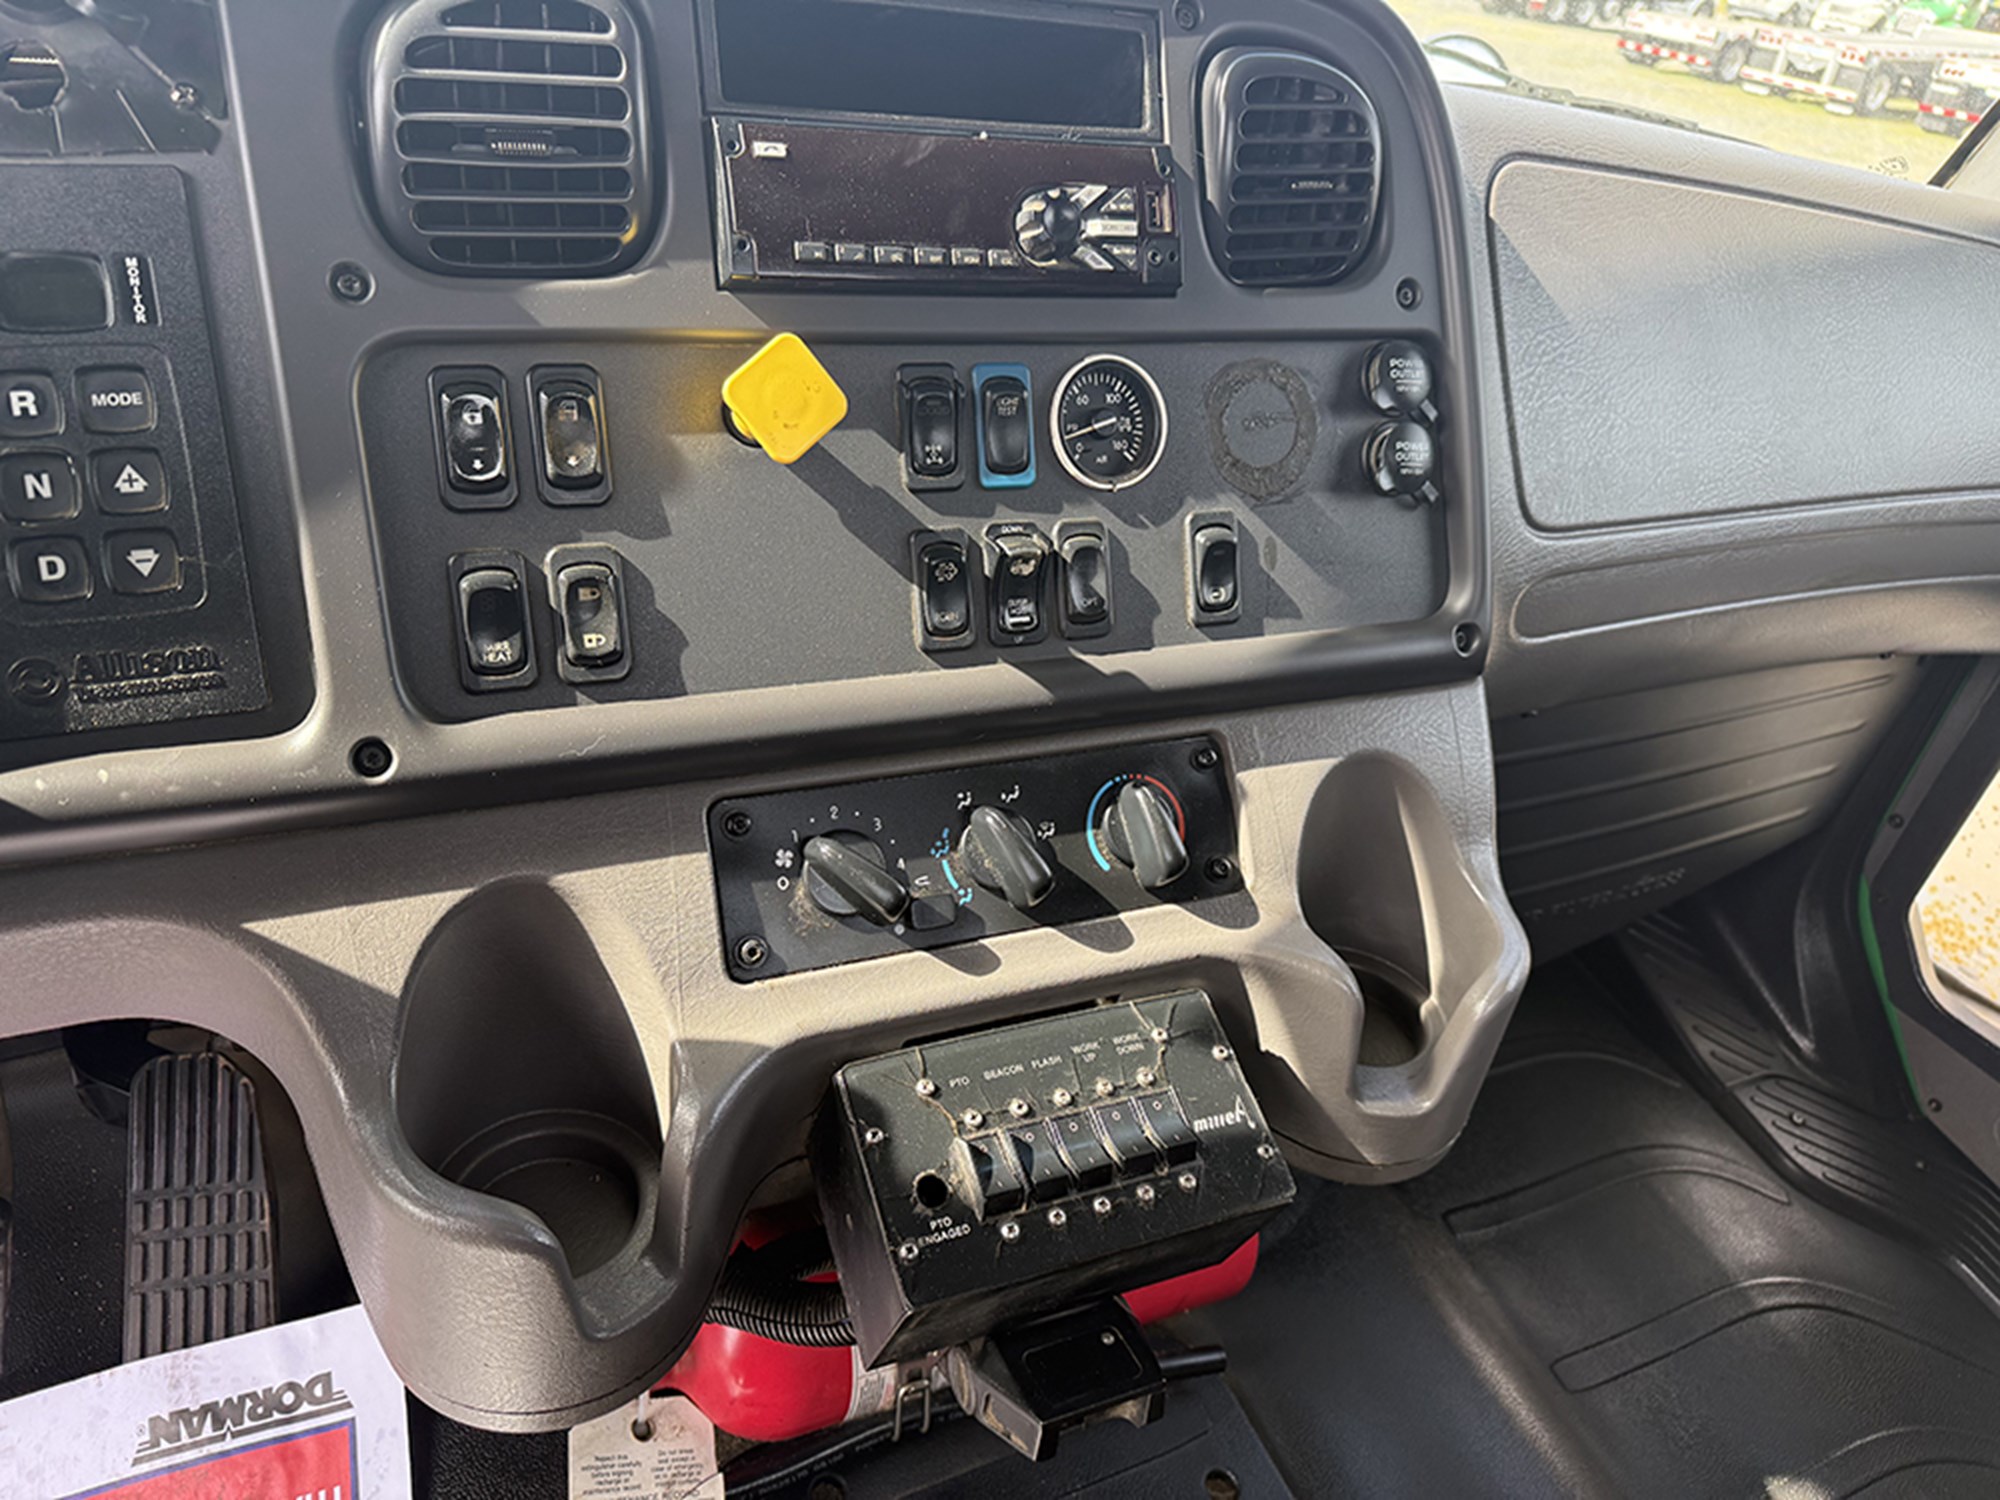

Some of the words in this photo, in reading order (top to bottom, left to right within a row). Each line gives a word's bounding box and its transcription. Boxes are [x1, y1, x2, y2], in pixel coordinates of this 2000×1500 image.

[125, 256, 148, 324] MONITOR
[8, 389, 39, 417] R
[90, 391, 144, 407] MODE
[1105, 393, 1122, 404] 100
[23, 472, 53, 499] N
[37, 554, 67, 582] D
[829, 805, 840, 820] 2
[873, 817, 882, 832] 3
[791, 829, 799, 843] 1
[896, 857, 906, 871] 4
[1112, 1032, 1141, 1045] WORK
[1070, 1041, 1101, 1055] WORK
[1115, 1042, 1145, 1056] DOWN
[1031, 1055, 1062, 1069] FLASH
[1081, 1052, 1096, 1063] UP
[983, 1063, 1025, 1081] BEACON
[949, 1075, 970, 1088] PTO
[929, 1215, 953, 1231] PTO
[917, 1223, 971, 1248] ENGAGED
[147, 1371, 334, 1448] DORMAN
